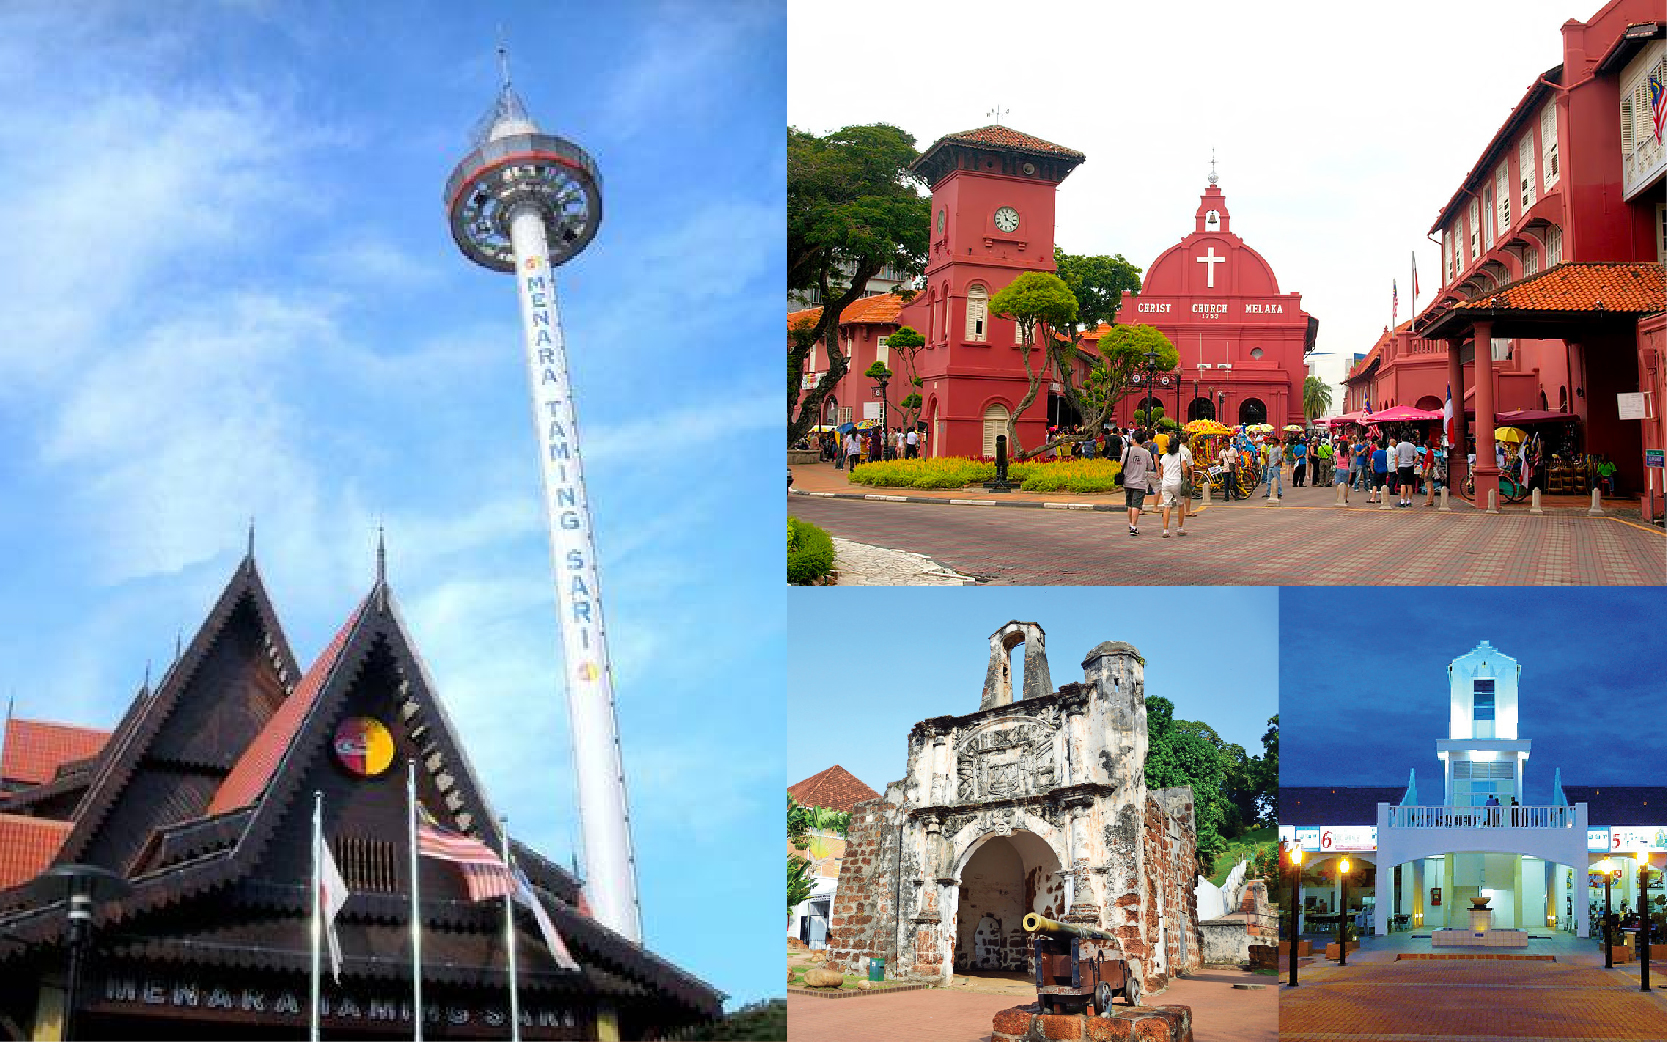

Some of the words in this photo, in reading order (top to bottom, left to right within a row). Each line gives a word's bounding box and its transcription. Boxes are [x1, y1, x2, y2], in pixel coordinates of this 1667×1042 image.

[1137, 302, 1172, 313] CHRIST
[1191, 303, 1228, 313] CHURCH
[1245, 303, 1283, 314] MELAKA
[527, 276, 558, 386] MENARA
[545, 400, 579, 530] TAMING
[566, 548, 591, 650] SARI
[1322, 830, 1332, 849] 6
[1612, 833, 1621, 849] 5
